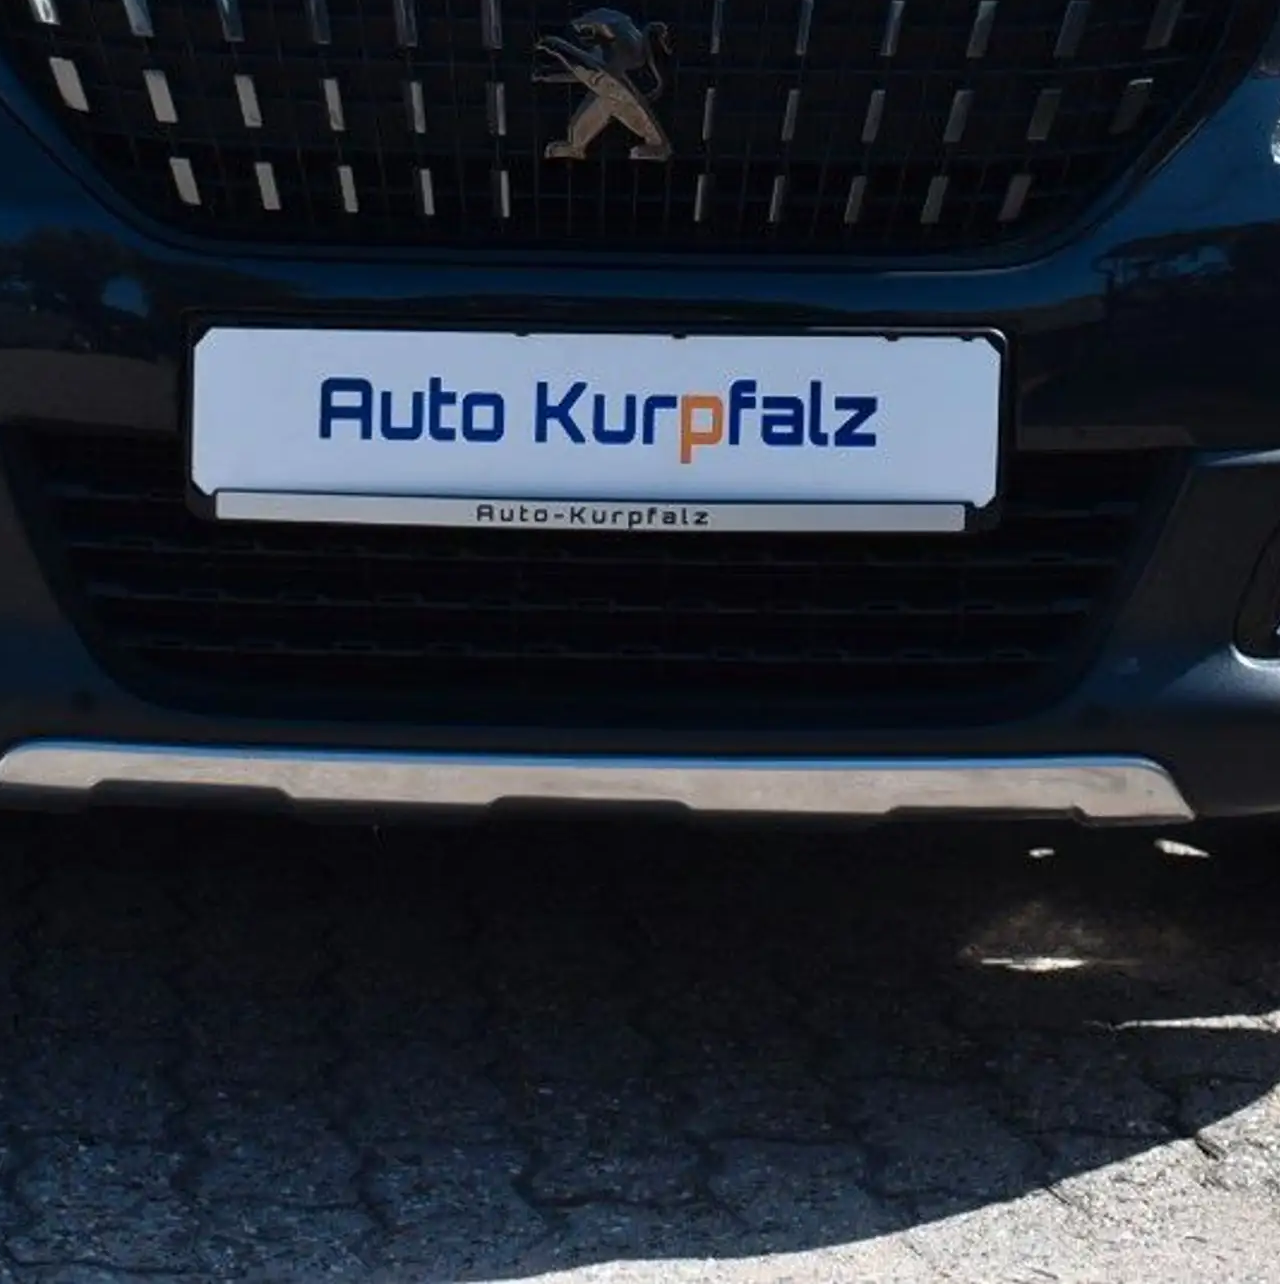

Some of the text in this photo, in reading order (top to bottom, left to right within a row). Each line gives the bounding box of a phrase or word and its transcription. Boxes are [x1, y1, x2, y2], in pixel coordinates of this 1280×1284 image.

[319, 376, 879, 465] Auto Kurpfalz
[476, 504, 709, 528] Auto-Kurpfalz
